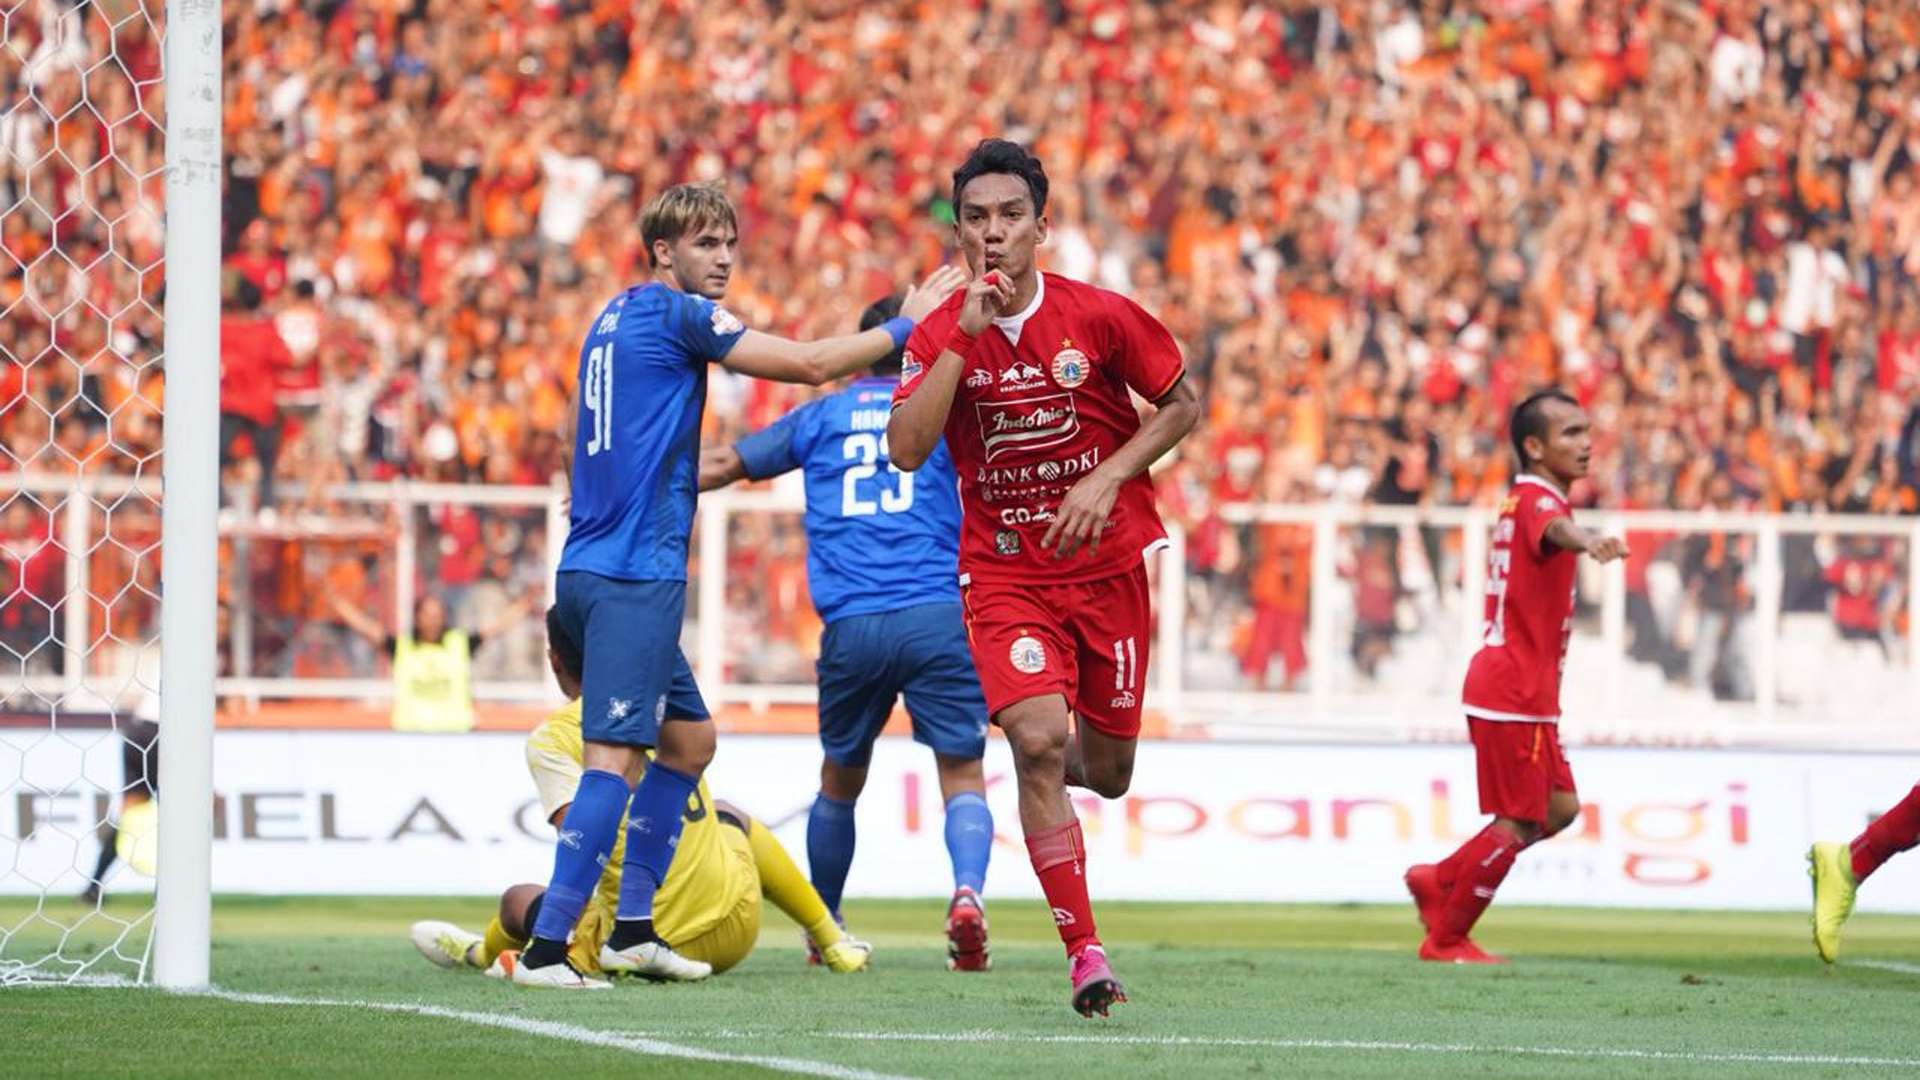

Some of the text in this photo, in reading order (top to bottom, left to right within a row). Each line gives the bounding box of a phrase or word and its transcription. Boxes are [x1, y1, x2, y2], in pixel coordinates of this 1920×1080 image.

[585, 341, 613, 456] 91
[977, 447, 1099, 484] BANK DKI
[1113, 637, 1137, 690] 11
